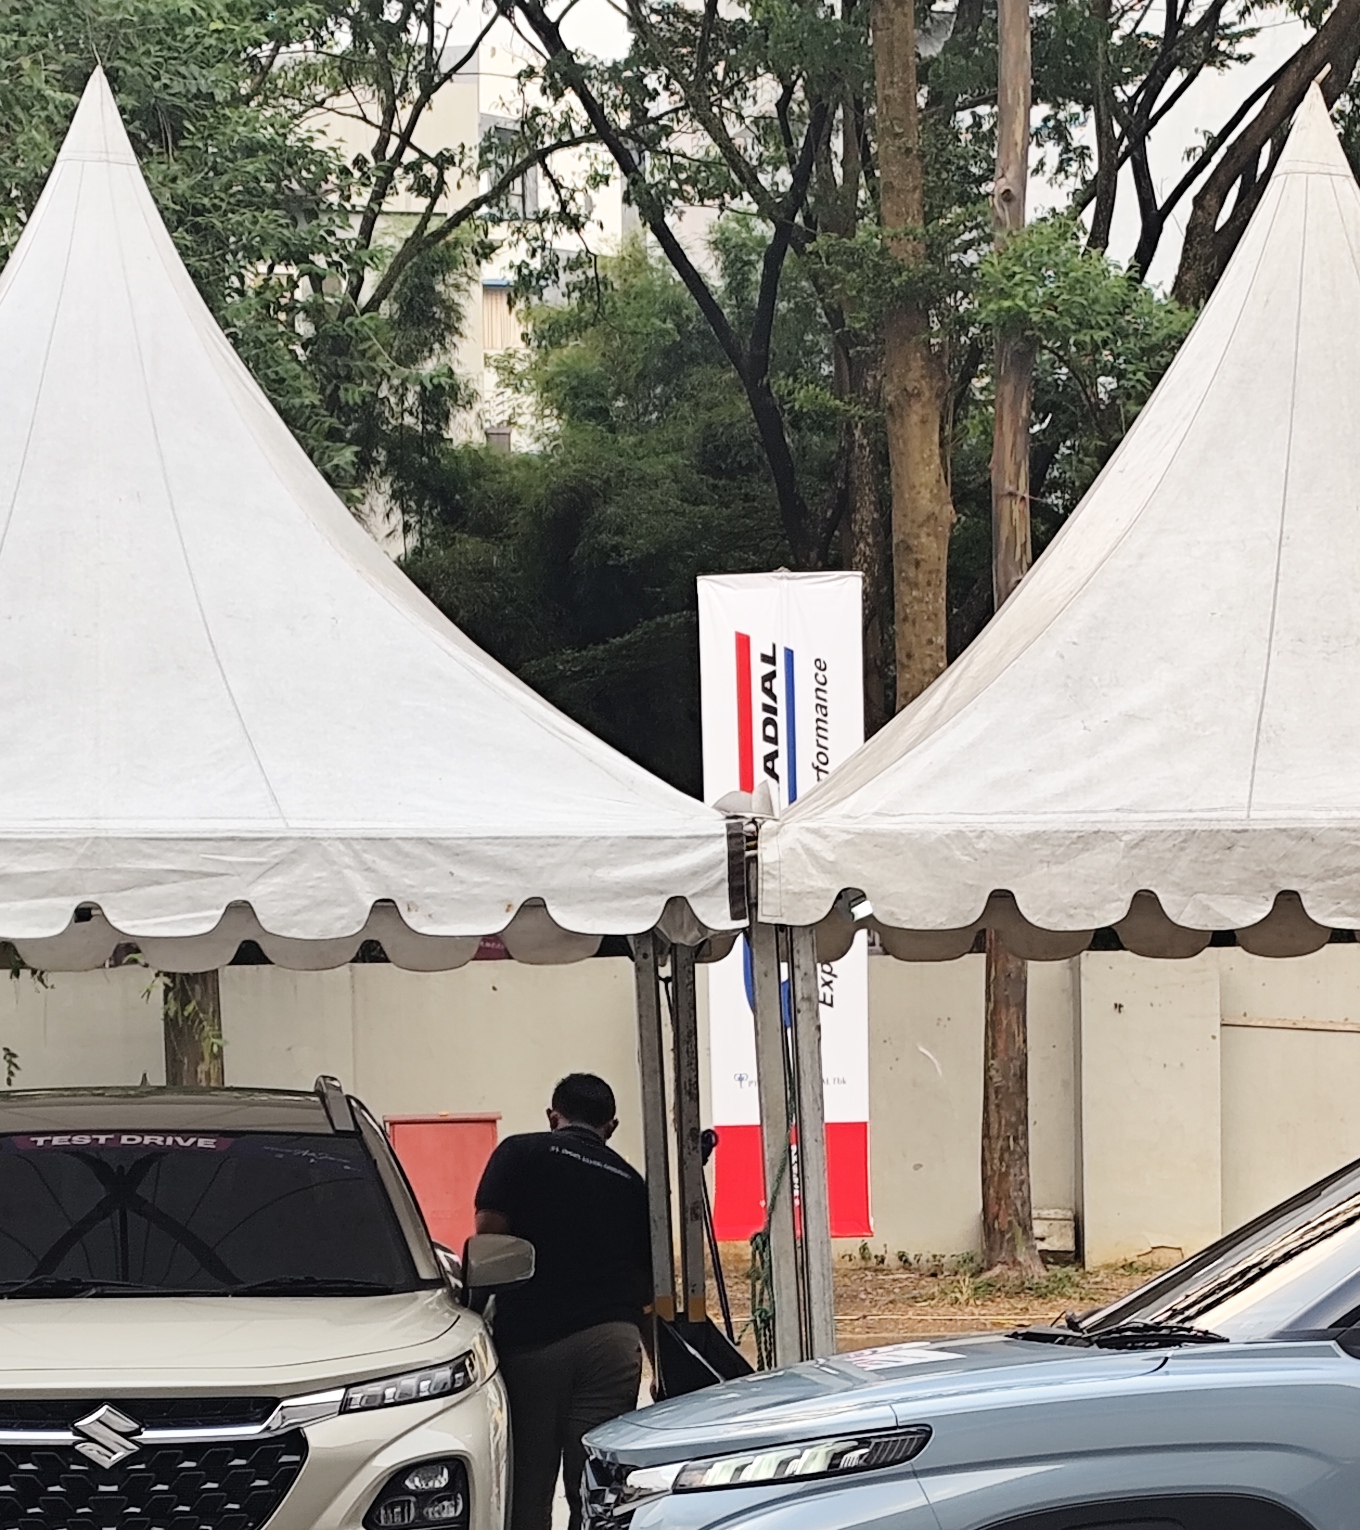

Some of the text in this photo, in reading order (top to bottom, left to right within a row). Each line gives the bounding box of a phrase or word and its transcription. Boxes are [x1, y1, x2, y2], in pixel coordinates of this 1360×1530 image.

[760, 642, 779, 784] ADIAL
[30, 1134, 217, 1148] TEST DRIVE
